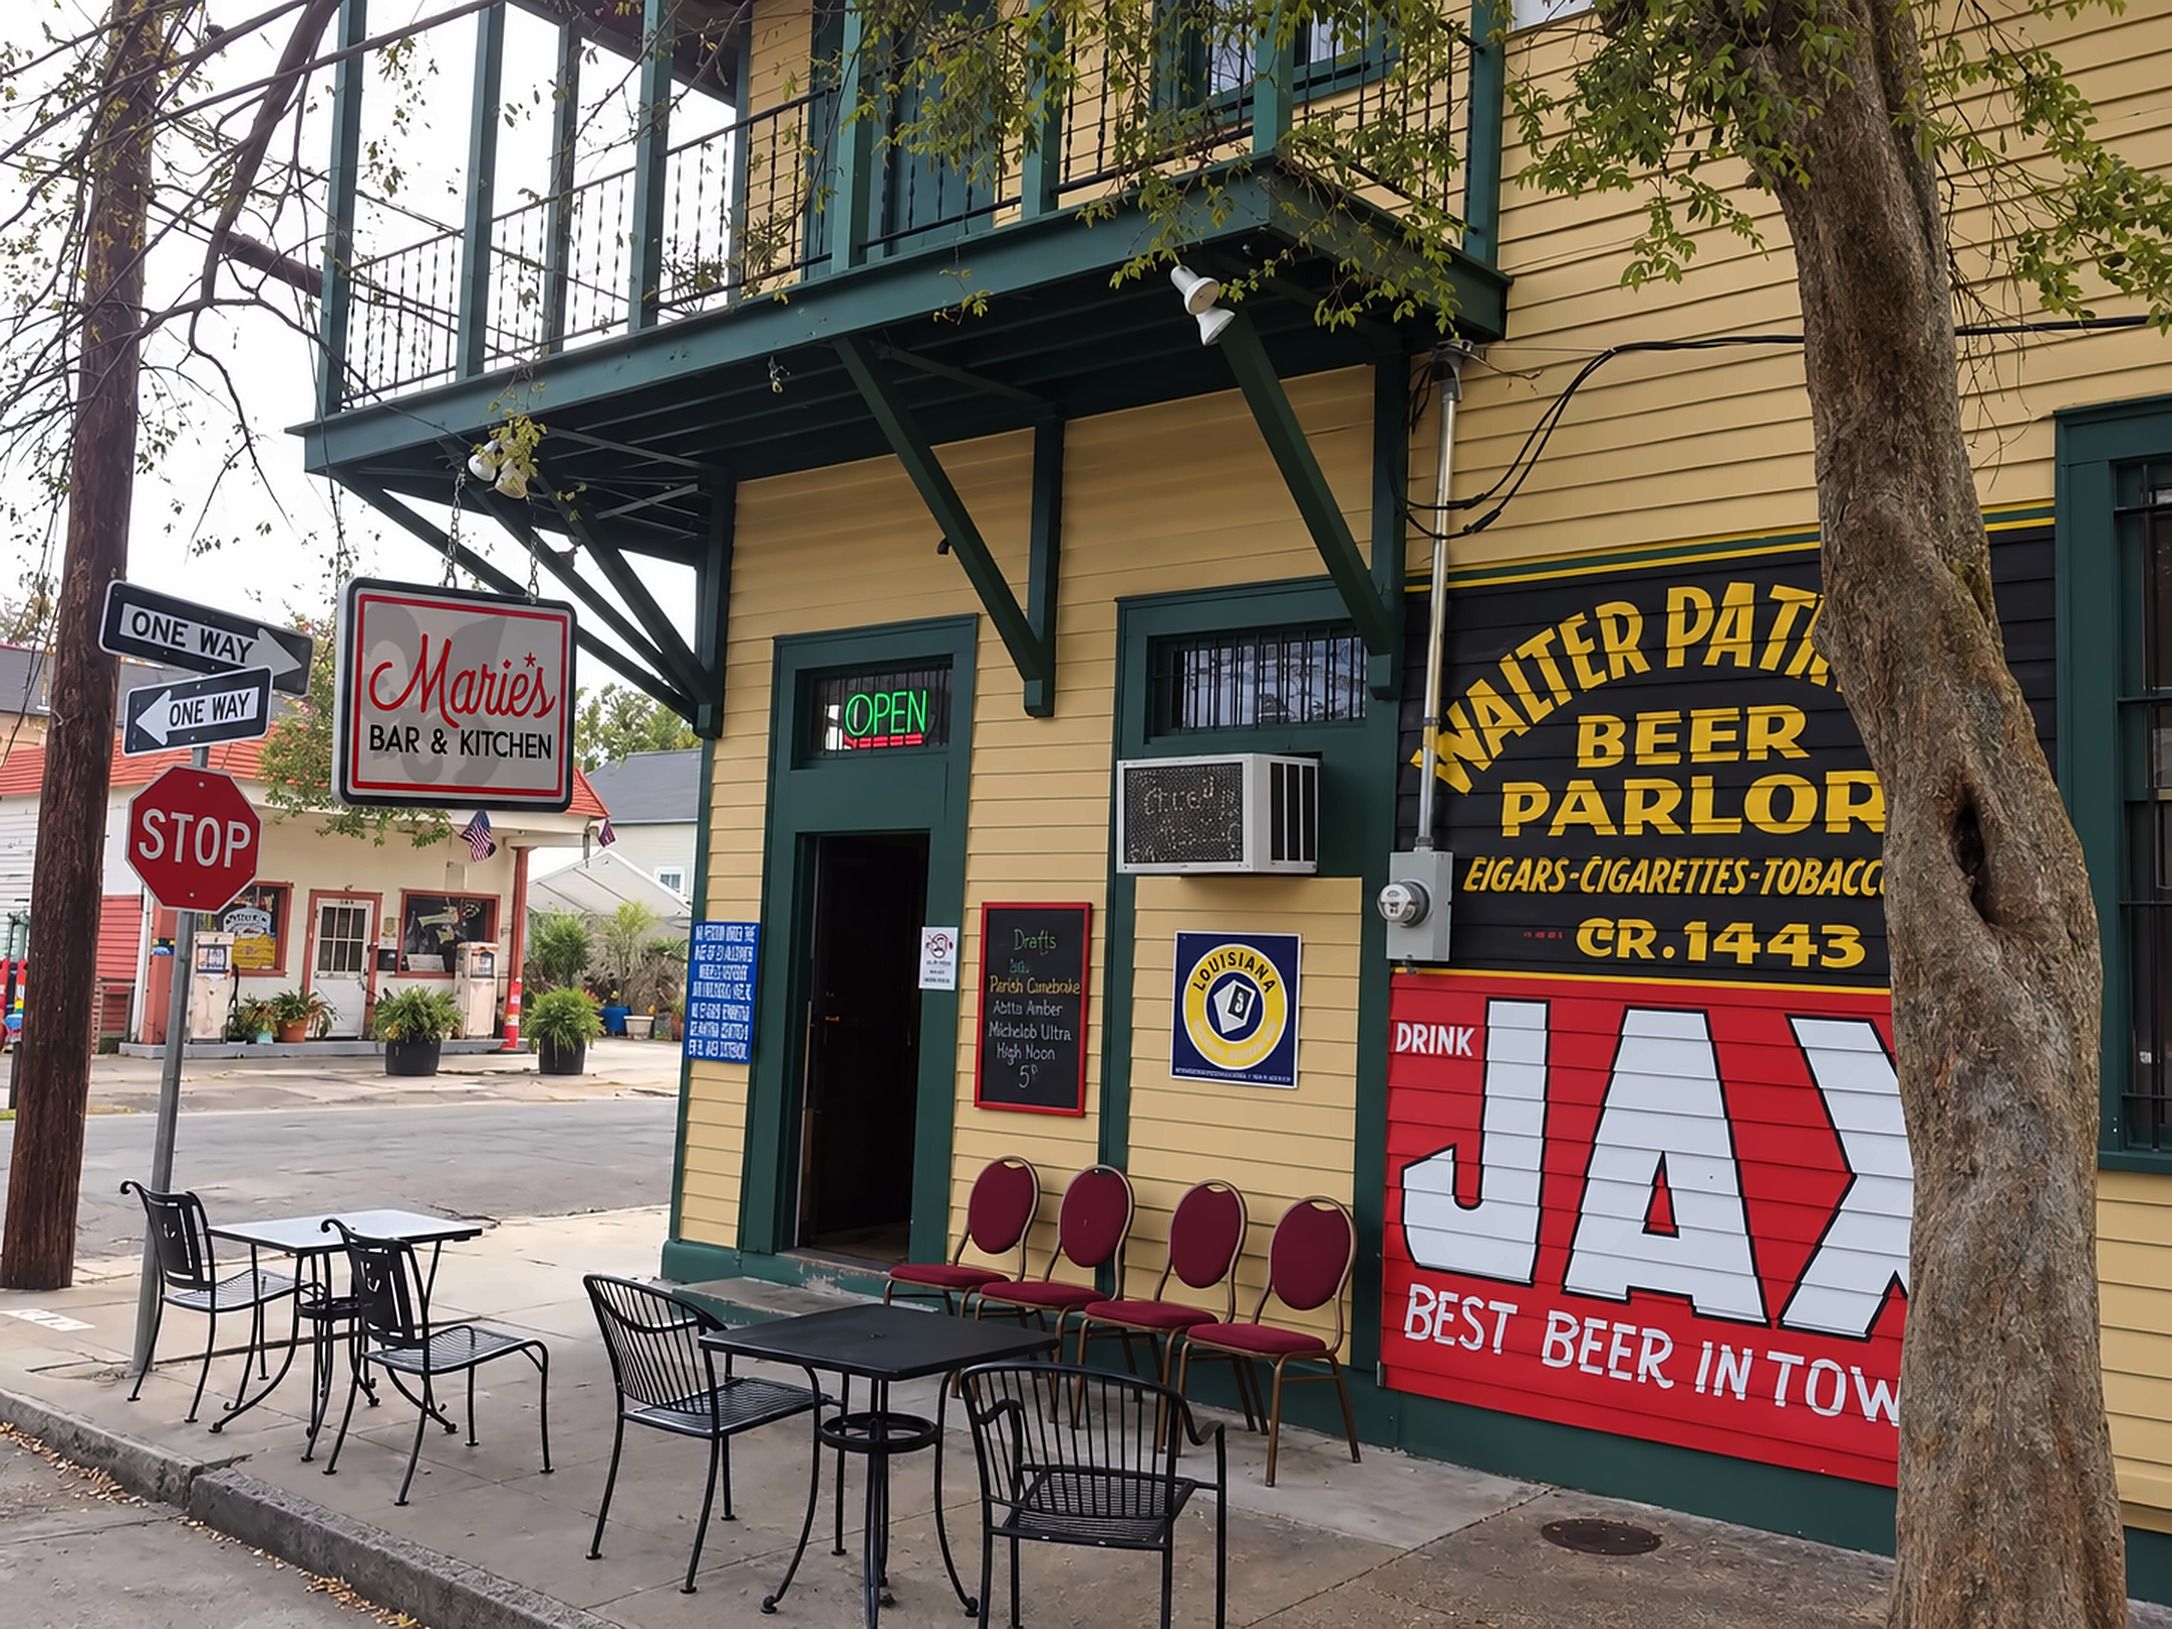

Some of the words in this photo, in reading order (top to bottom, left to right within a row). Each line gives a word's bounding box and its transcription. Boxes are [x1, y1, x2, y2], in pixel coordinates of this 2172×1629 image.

[131, 611, 188, 648] ONE
[200, 627, 254, 664] WAY
[369, 633, 556, 729] Marie's
[1410, 600, 1651, 795] WALTER
[1666, 581, 1843, 692] PAT
[169, 699, 205, 727] ONE
[212, 692, 250, 722] WAY
[845, 689, 926, 736] OPEN
[369, 724, 420, 754] BAR
[430, 728, 448, 755] &
[460, 730, 552, 760] KITCHEN
[1577, 704, 1811, 769] BEER
[1502, 770, 1886, 838] PARLOR
[138, 808, 251, 868] STOP
[1014, 928, 1057, 950] Drafts
[1192, 951, 1277, 994] LOUISIANA
[988, 1021, 1038, 1039] Michelob
[1041, 1023, 1072, 1040] Ultra
[1026, 1000, 1063, 1016] Amber
[996, 1042, 1023, 1066] High
[1026, 1043, 1056, 1060] Noon
[1395, 1022, 1475, 1056] DRINK
[1402, 998, 1914, 1340] JAX
[1404, 1283, 1517, 1354] BEST
[1541, 1309, 1675, 1389] BEER
[1695, 1340, 1754, 1400] IN
